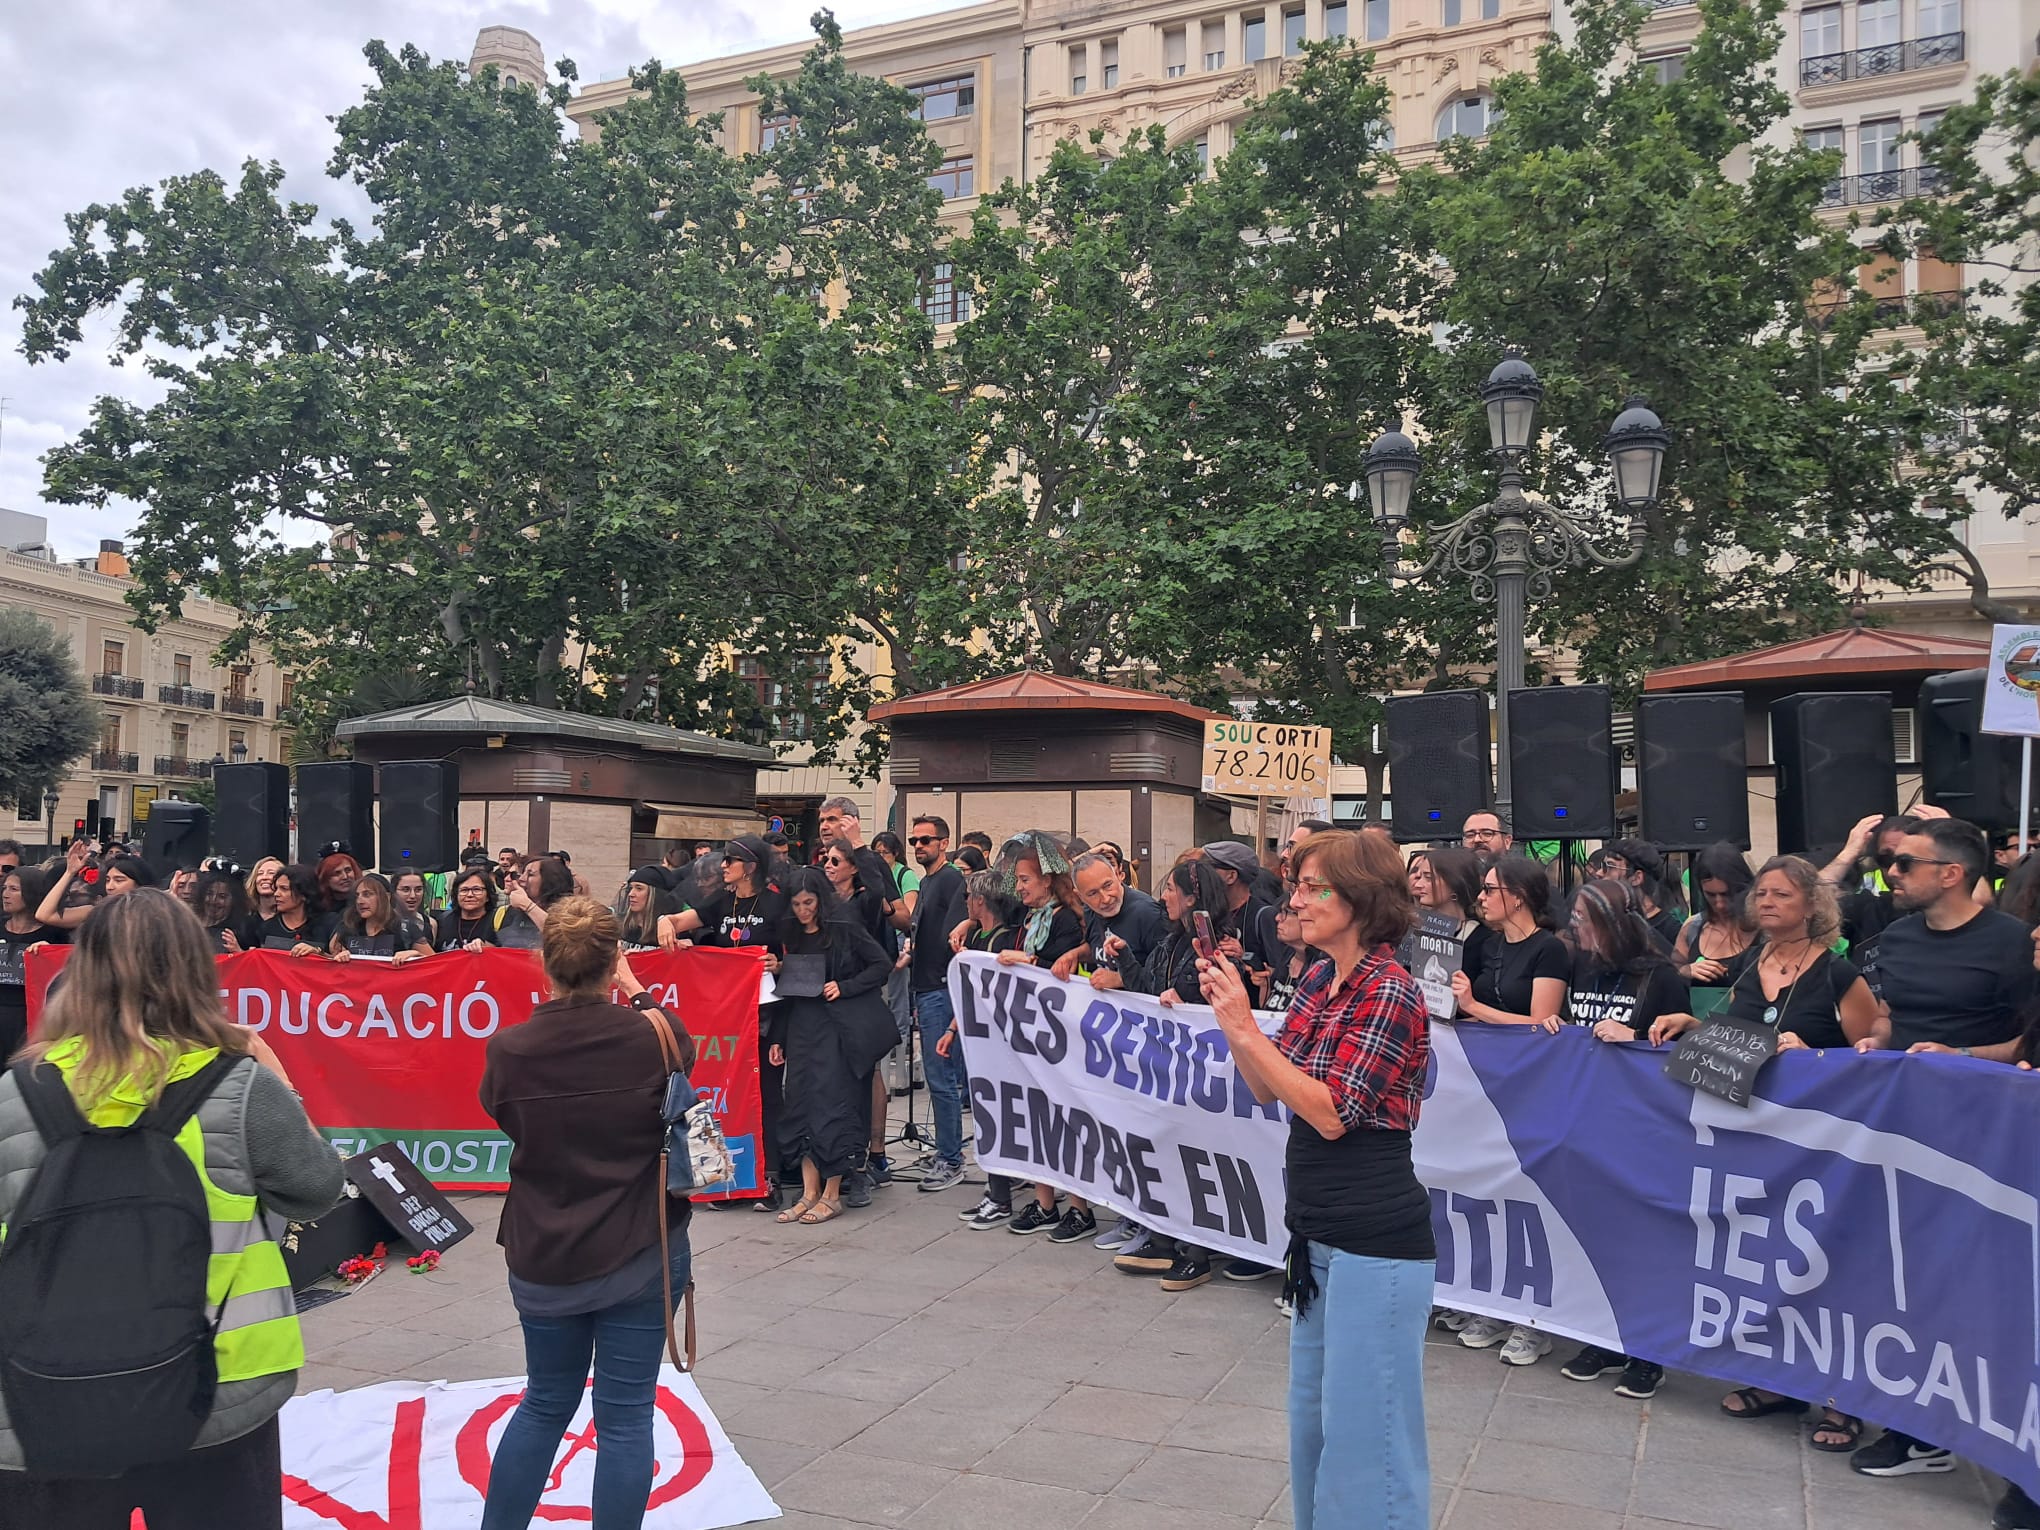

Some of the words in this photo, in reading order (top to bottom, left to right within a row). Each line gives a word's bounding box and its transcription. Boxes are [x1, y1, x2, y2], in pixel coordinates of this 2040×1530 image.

[1998, 630, 2040, 661] ASSEMBLE
[1999, 676, 2010, 688] DE
[2009, 687, 2036, 699] L'HOR
[1214, 723, 1252, 744] SOU
[1256, 726, 1272, 744] C.
[1275, 725, 1320, 748] ORTÍ
[1573, 992, 1585, 1000] PER
[1585, 992, 1603, 1001] UNA
[958, 962, 1067, 1065] L'IES
[1080, 999, 1292, 1122] BENICA
[1688, 1033, 1710, 1046] NO
[1704, 1022, 1745, 1044] MORTA
[1679, 1048, 1699, 1061] UN
[396, 1140, 509, 1173] NOST
[1178, 1143, 1268, 1246] EN
[1689, 1166, 1829, 1296] IES
